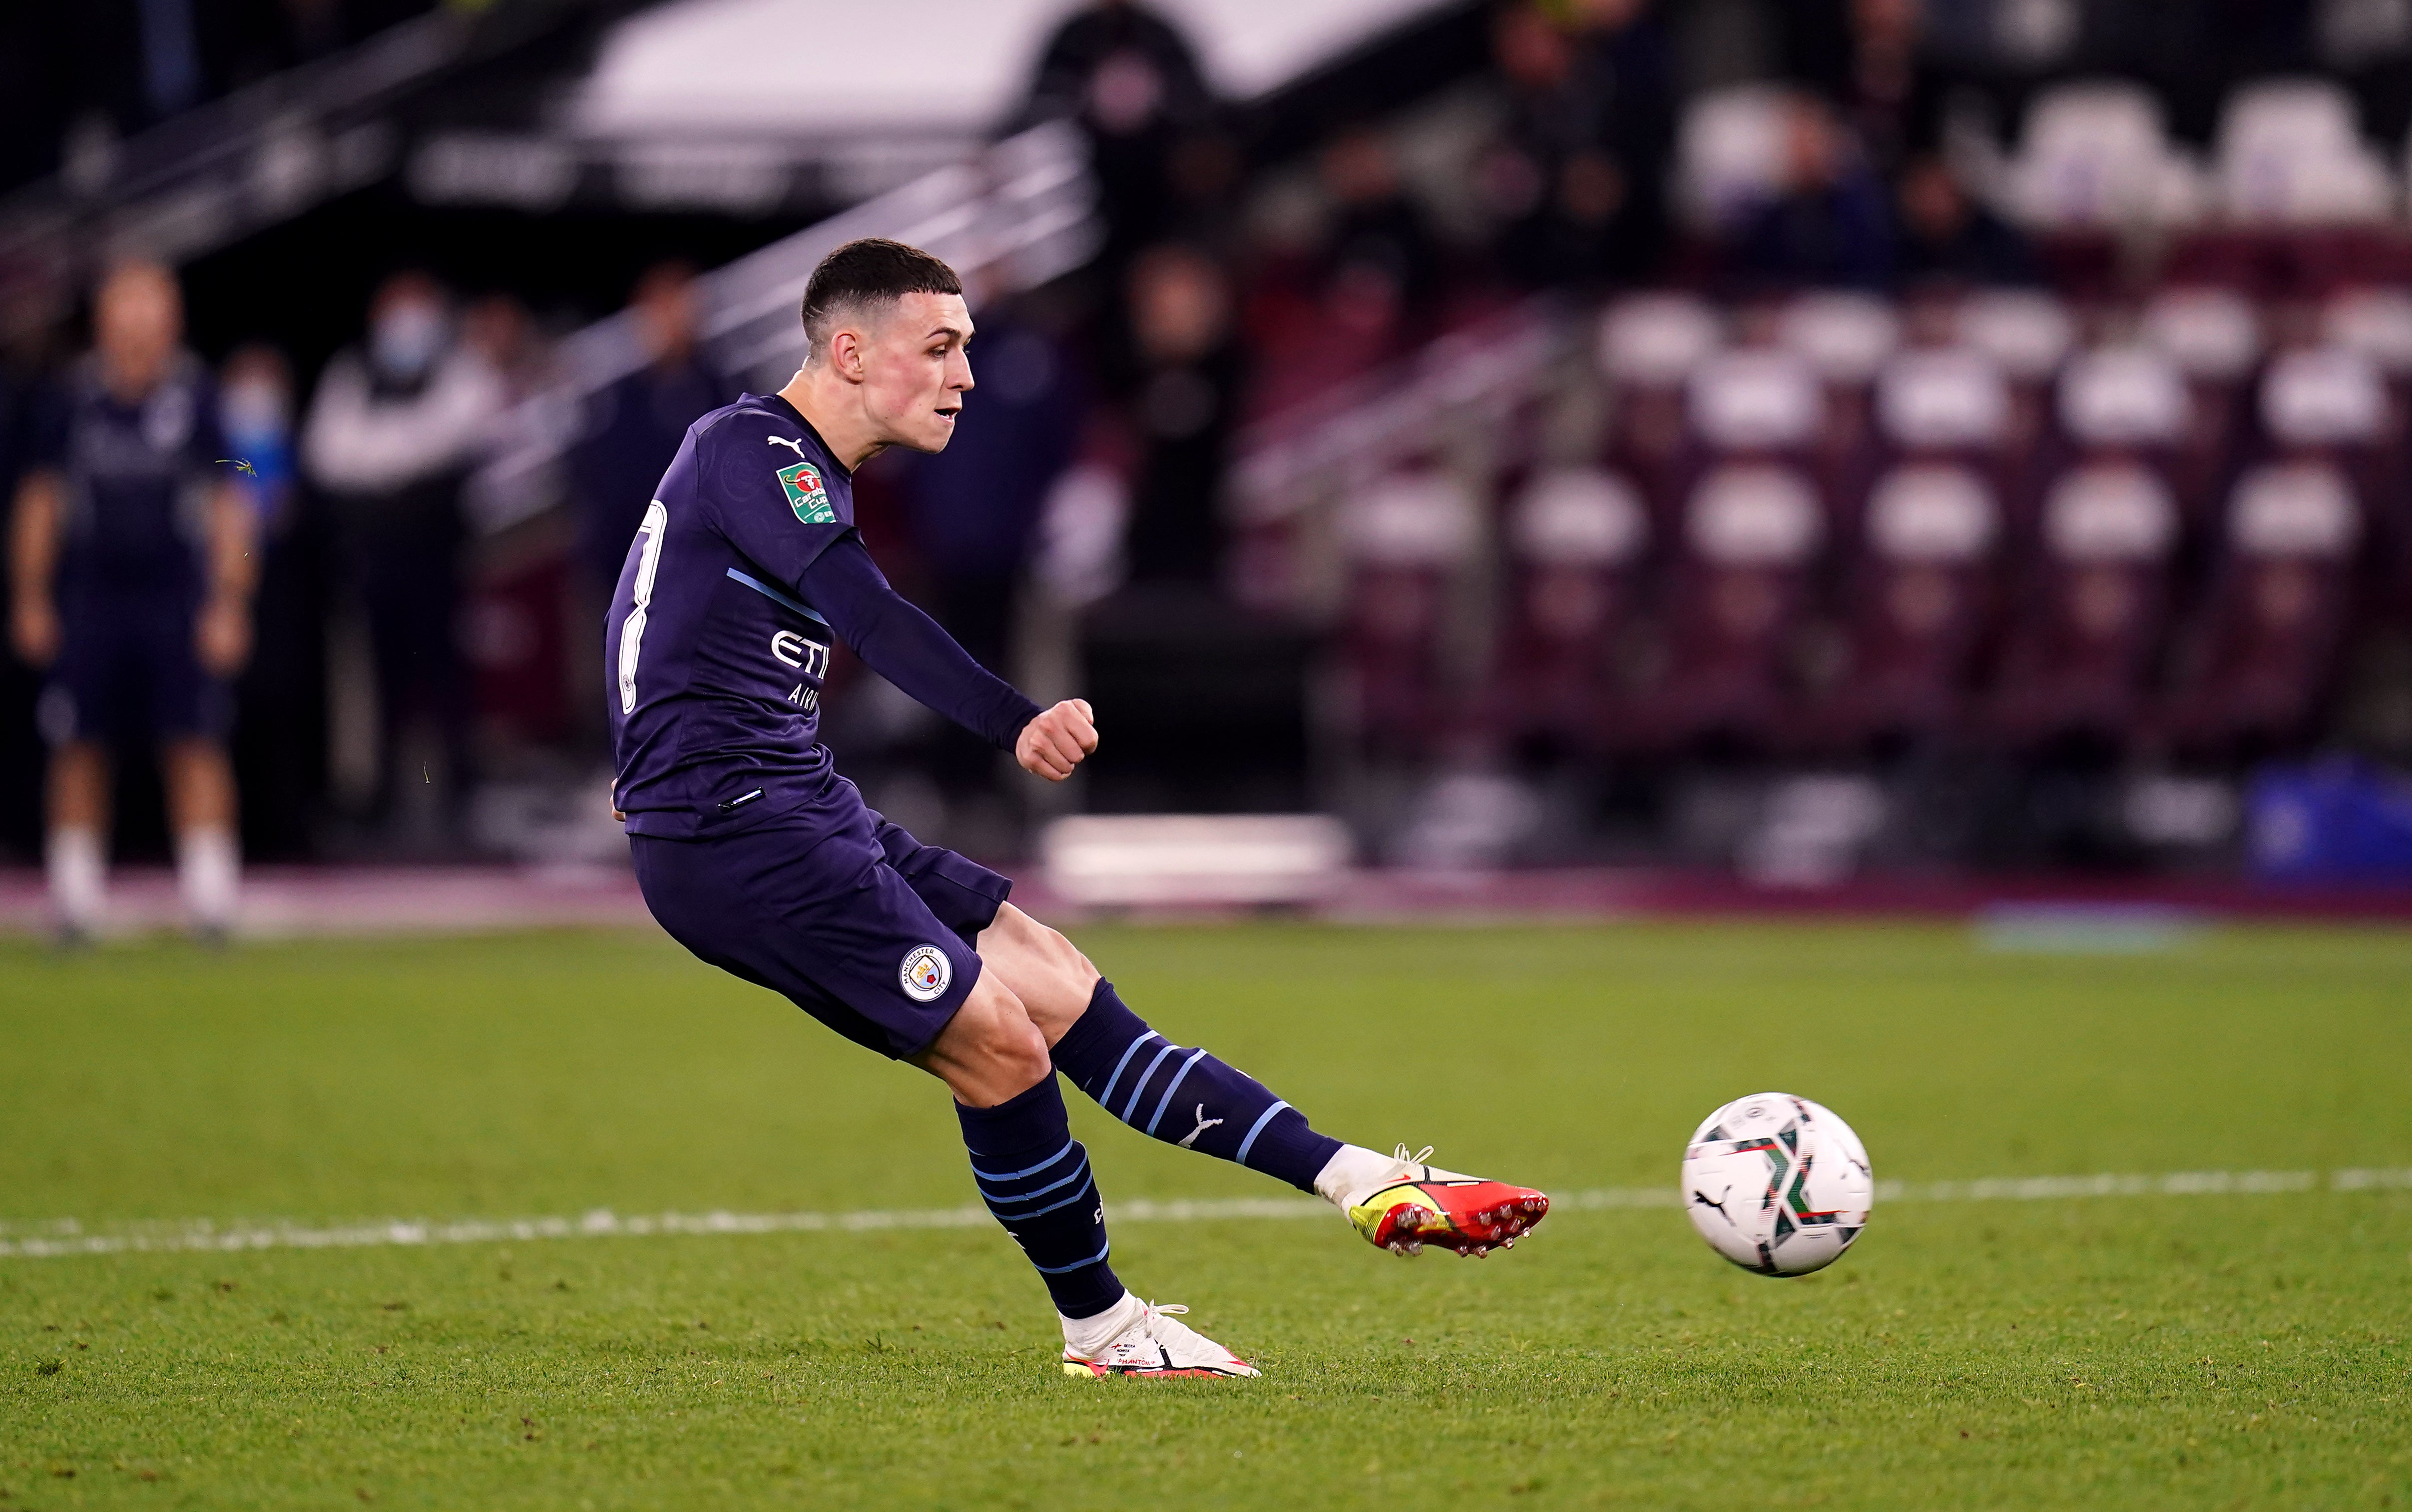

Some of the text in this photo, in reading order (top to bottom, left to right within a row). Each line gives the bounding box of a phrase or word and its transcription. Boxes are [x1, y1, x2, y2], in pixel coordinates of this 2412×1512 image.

[809, 496, 828, 509] Cup
[903, 948, 946, 995] MANCHESTER CITY
